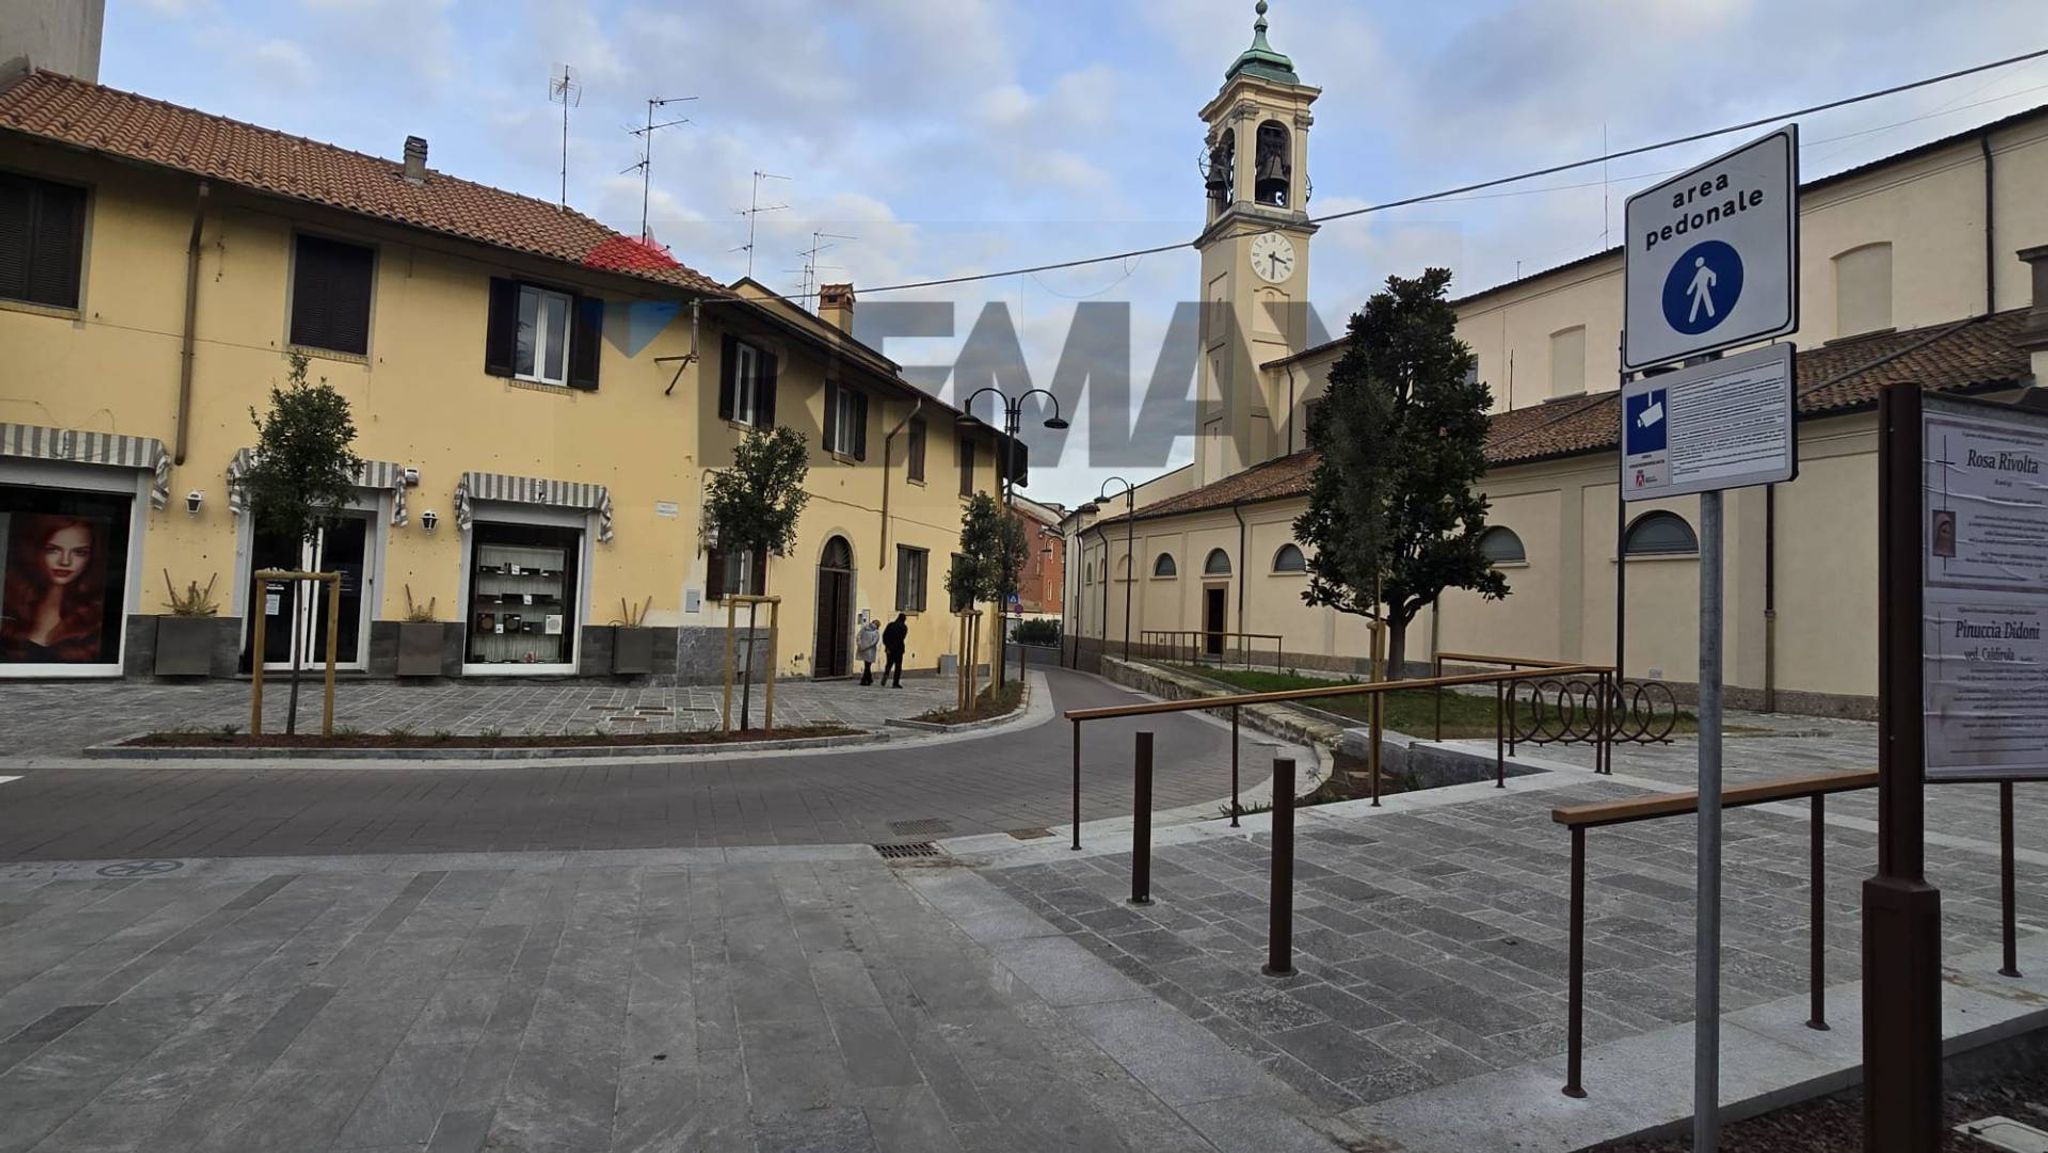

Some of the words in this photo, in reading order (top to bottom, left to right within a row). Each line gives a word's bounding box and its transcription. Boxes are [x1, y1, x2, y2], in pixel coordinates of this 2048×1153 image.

[1672, 174, 1728, 208] area
[1646, 189, 1763, 251] pedonale
[1966, 448, 1996, 469] Rosa
[1998, 452, 2039, 474] Rivolta
[1955, 619, 2001, 639] Pinuccia
[2003, 621, 2040, 640] Didoni
